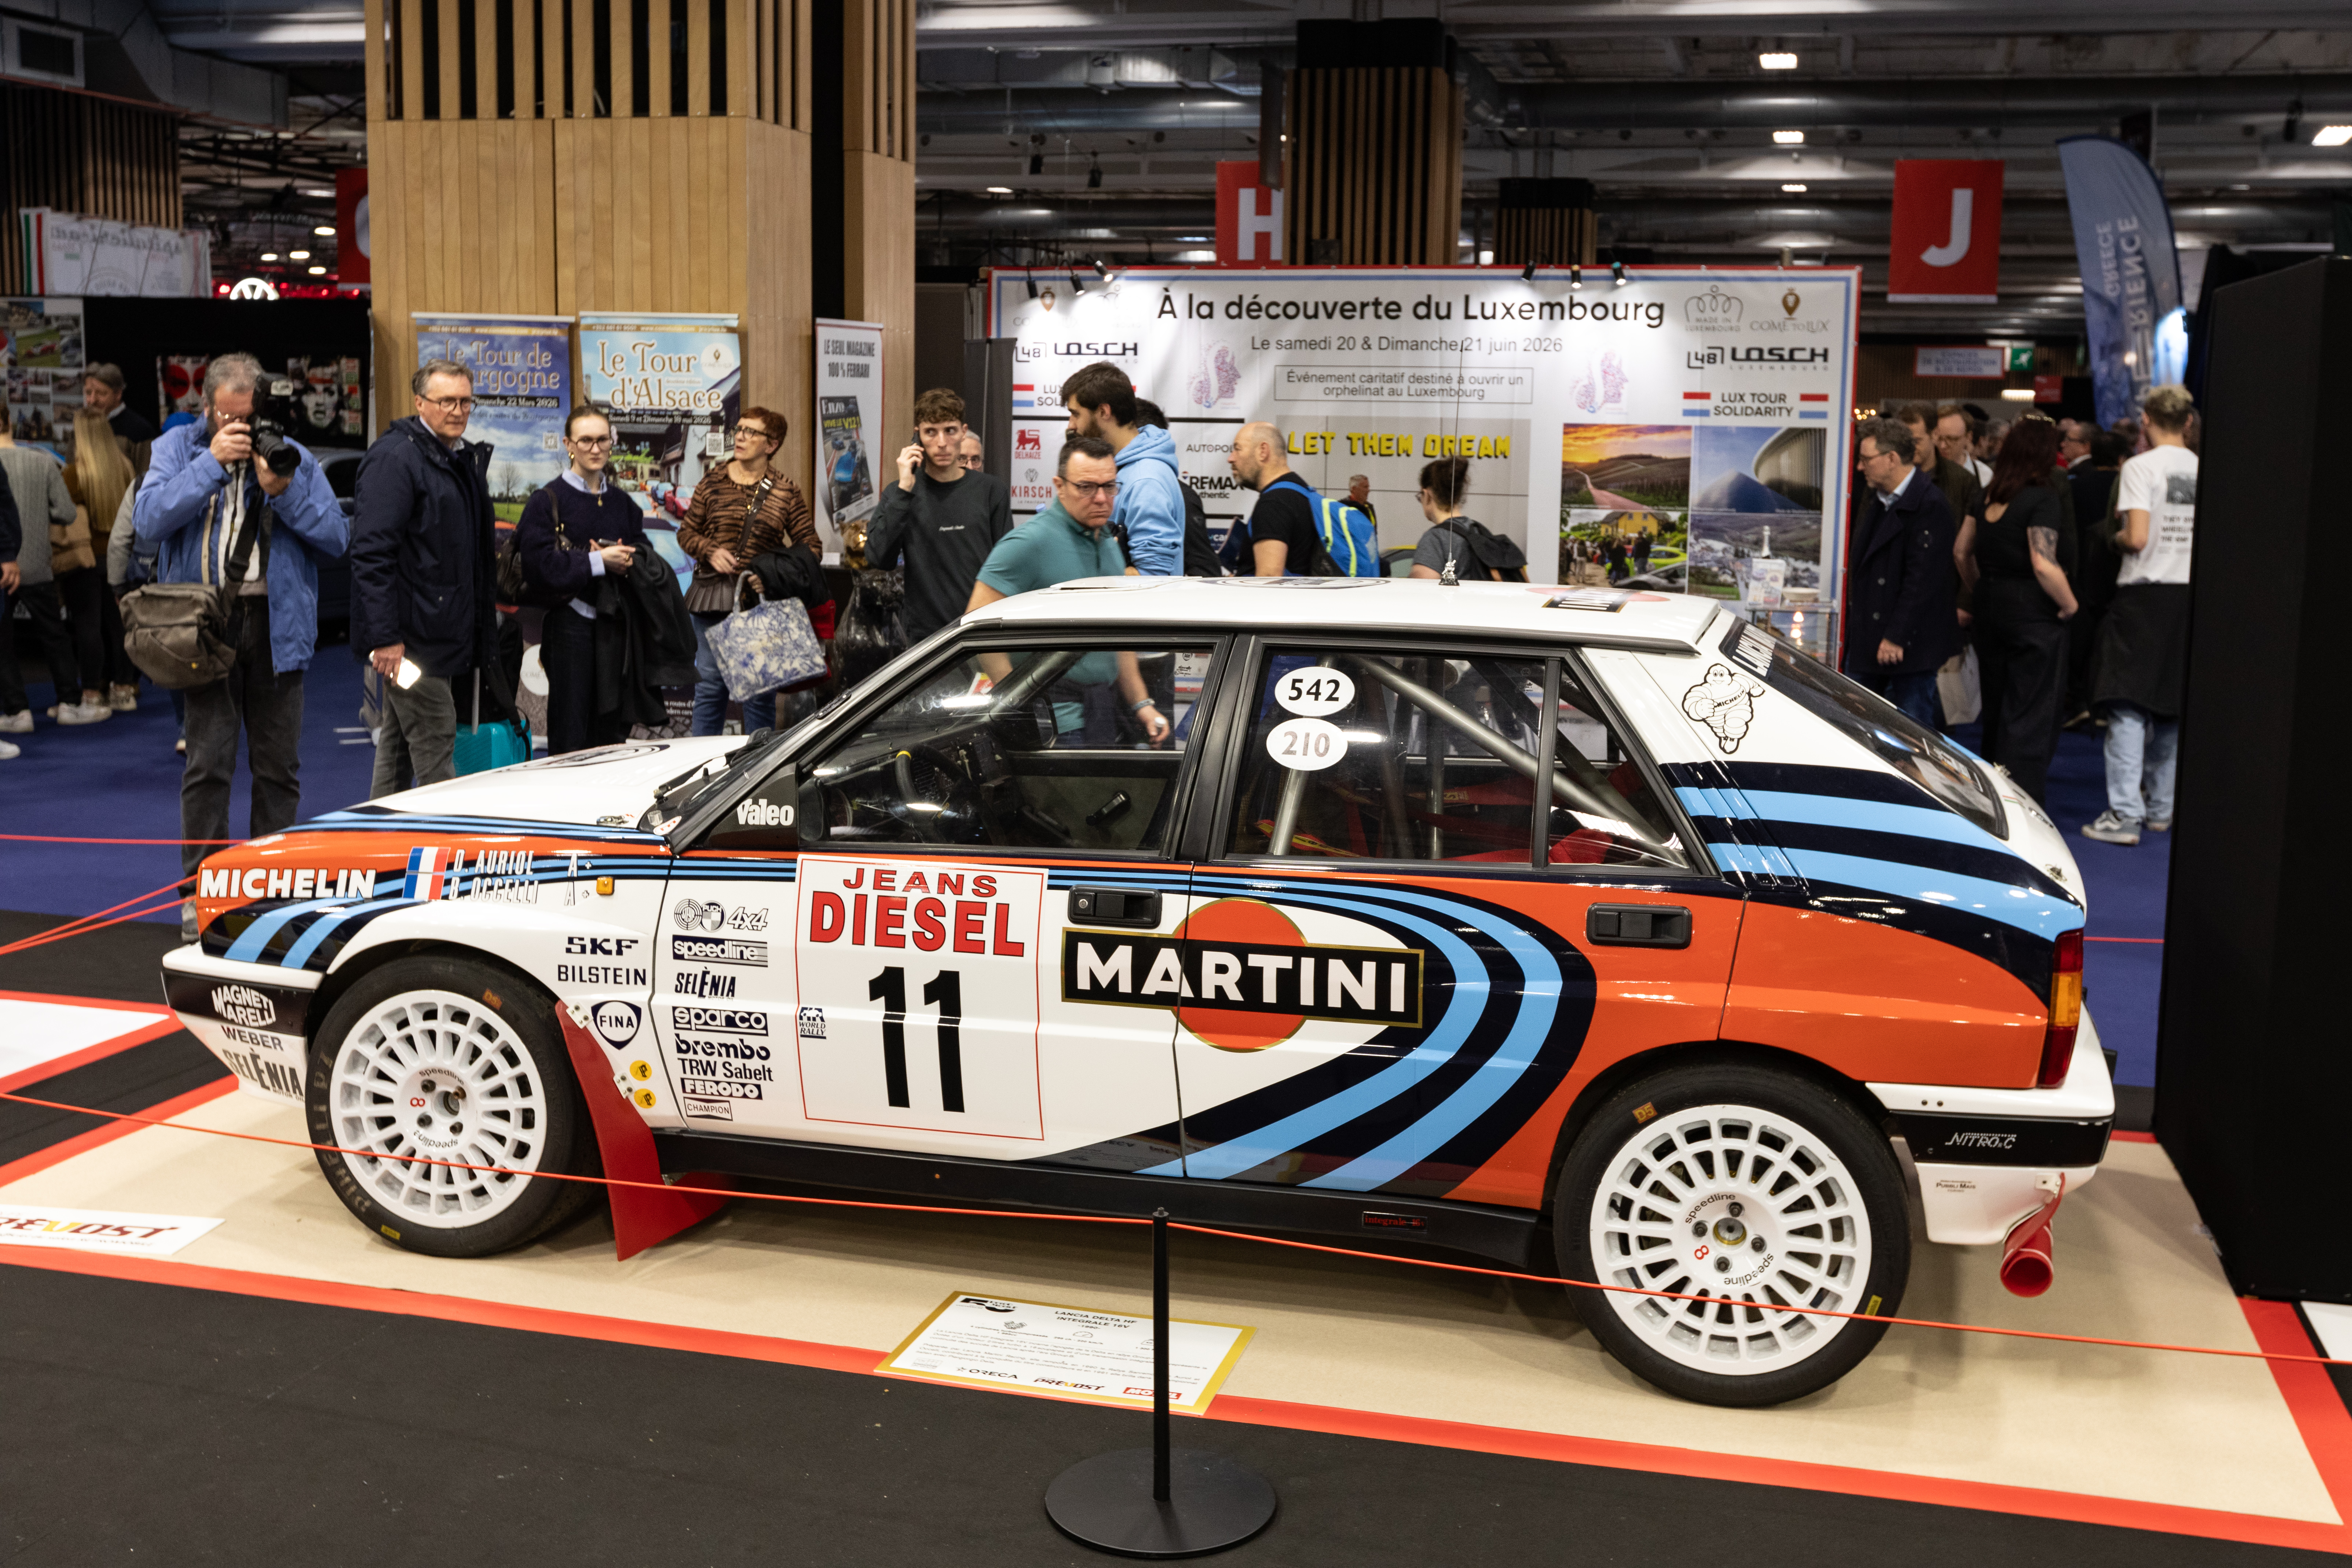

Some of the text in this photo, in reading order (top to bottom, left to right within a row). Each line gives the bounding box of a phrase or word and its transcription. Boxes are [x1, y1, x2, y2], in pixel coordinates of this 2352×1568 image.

[1237, 188, 1284, 260] H
[1920, 188, 1973, 267] J
[1157, 288, 1665, 329] À la découverte du Luxembourg
[470, 340, 522, 366] Tour
[526, 342, 552, 369] de
[831, 339, 845, 355] SEUL
[846, 341, 875, 357] MAGAZINE
[1054, 343, 1138, 356] LOSCH
[1251, 336, 1563, 355] Le samedi 20 & Dimanche 21 juin 2026
[1731, 346, 1829, 363] LOSCH
[600, 341, 697, 377] Le Tour
[828, 362, 839, 377] 100
[846, 362, 870, 378] FERRARI
[1287, 369, 1523, 385] Événement caritatif destiné à ouvrir un
[473, 369, 560, 395] rgogne
[1323, 385, 1485, 400] orphelinat au Luxembourg
[536, 396, 558, 408] 2026
[611, 377, 721, 410] d'Alsace
[1721, 392, 1787, 404] LUX TOUR
[643, 415, 673, 423] Dimanche
[693, 416, 711, 424] 2026
[1714, 406, 1793, 417] SOLIDARITY
[1186, 444, 1234, 453] AUTOPOL
[1288, 431, 1511, 458] LET THEM DREAM
[1014, 451, 1041, 460] DELHAIZE
[1011, 485, 1052, 498] KIRSCH
[1288, 678, 1340, 702] 542
[1716, 689, 1745, 708] MICHELIN
[1281, 731, 1330, 758] 210
[737, 798, 794, 826] Valeo
[453, 849, 534, 876] D. AURIOL
[200, 868, 377, 899] MICHELIN
[448, 876, 465, 900] B.
[842, 868, 998, 897] JEANS
[727, 906, 769, 931] 4x4
[810, 890, 1025, 958] DIESEL
[566, 936, 639, 955] SKF
[674, 940, 758, 961] speedline
[557, 964, 647, 986] BILSTEIN
[674, 966, 736, 999] SELÈNIA
[1077, 942, 1406, 1013] MARTINI
[212, 985, 276, 1014] MAGNETI
[212, 1003, 276, 1027] MARELLI
[600, 1015, 634, 1029] FINA
[674, 1007, 766, 1031] sparco
[799, 1021, 826, 1029] WORLD
[221, 1025, 284, 1052] WEBER
[800, 1028, 826, 1036] RALLY
[868, 966, 965, 1114] 11
[674, 1033, 771, 1061] brembo
[222, 1047, 304, 1097] SELÈNIA
[419, 1067, 465, 1086] speedline
[677, 1057, 773, 1082] TRW Sabelt
[683, 1079, 759, 1099] FERODO
[687, 1103, 730, 1114] CHAMPION
[1634, 1104, 1655, 1121] D5
[414, 1130, 458, 1149] speedline
[1685, 1193, 1736, 1224] speedline
[0, 1217, 179, 1238] EVOST
[1364, 1215, 1407, 1226] integrale
[1723, 1252, 1774, 1287] speedline
[1056, 1316, 1111, 1326] INTEGRALE
[967, 1368, 1021, 1379] ORECA
[1033, 1377, 1105, 1391] PREVOST
[1126, 1388, 1180, 1399] MOL
